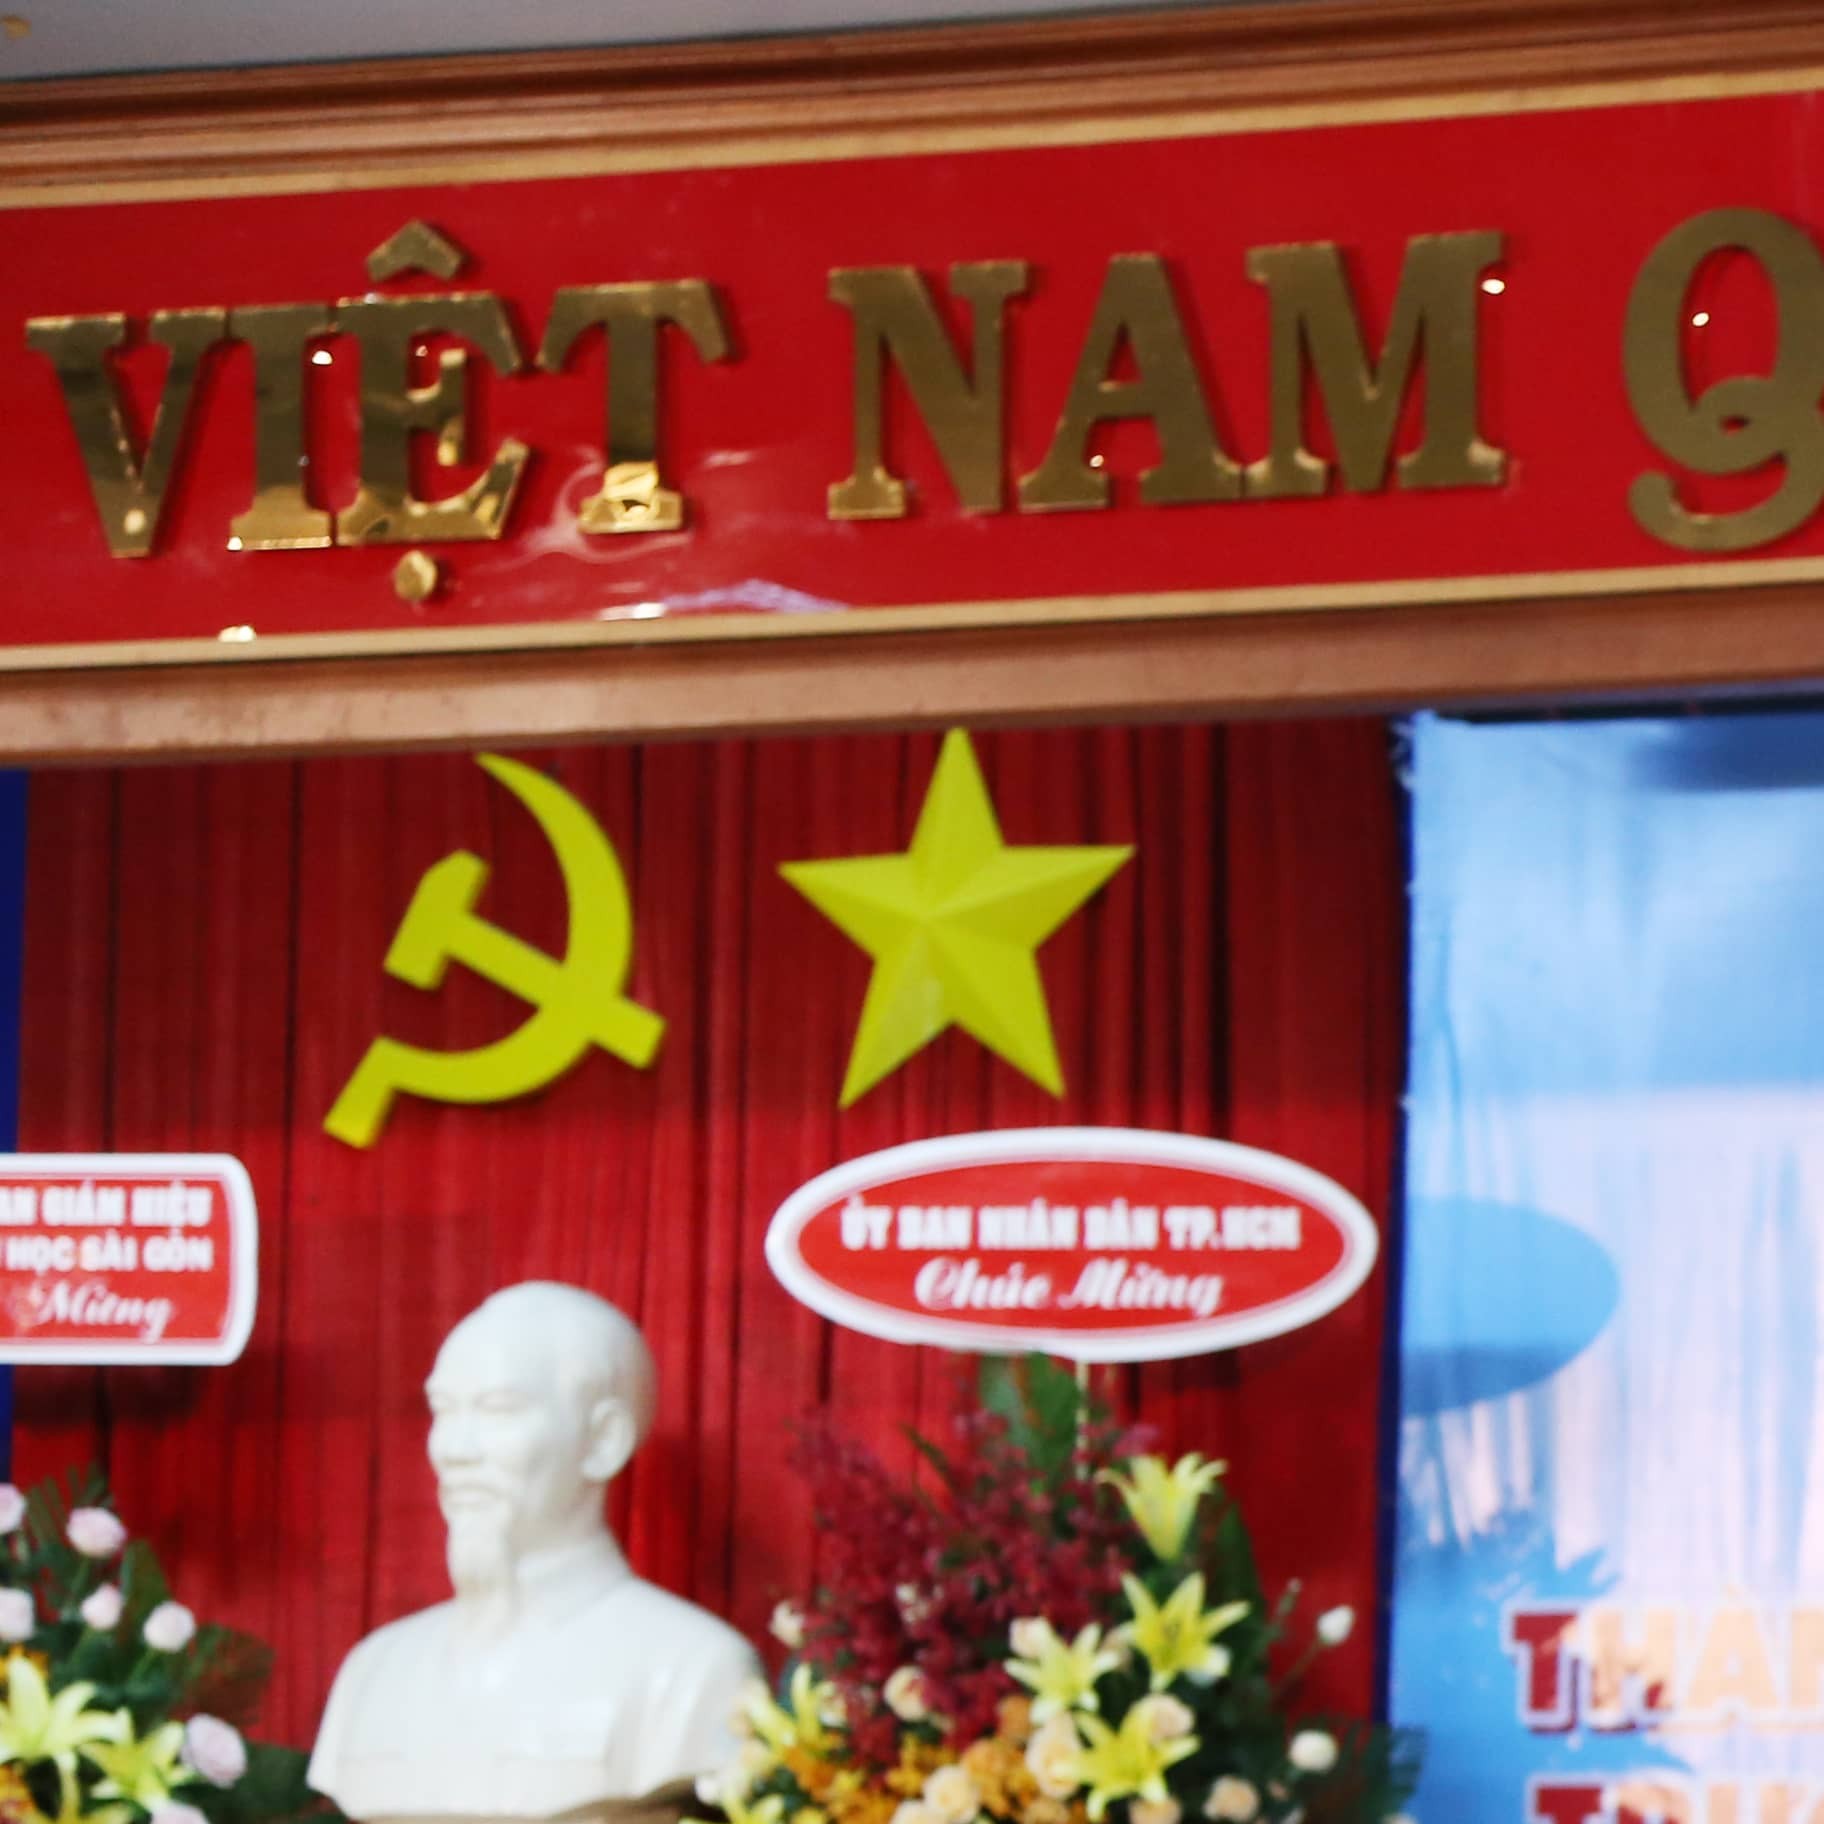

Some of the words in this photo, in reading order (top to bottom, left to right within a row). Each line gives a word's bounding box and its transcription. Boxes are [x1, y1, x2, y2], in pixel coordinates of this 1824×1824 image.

[25, 219, 732, 603] VIỆT
[828, 231, 1505, 519] NAM
[898, 1205, 974, 1251] BAN
